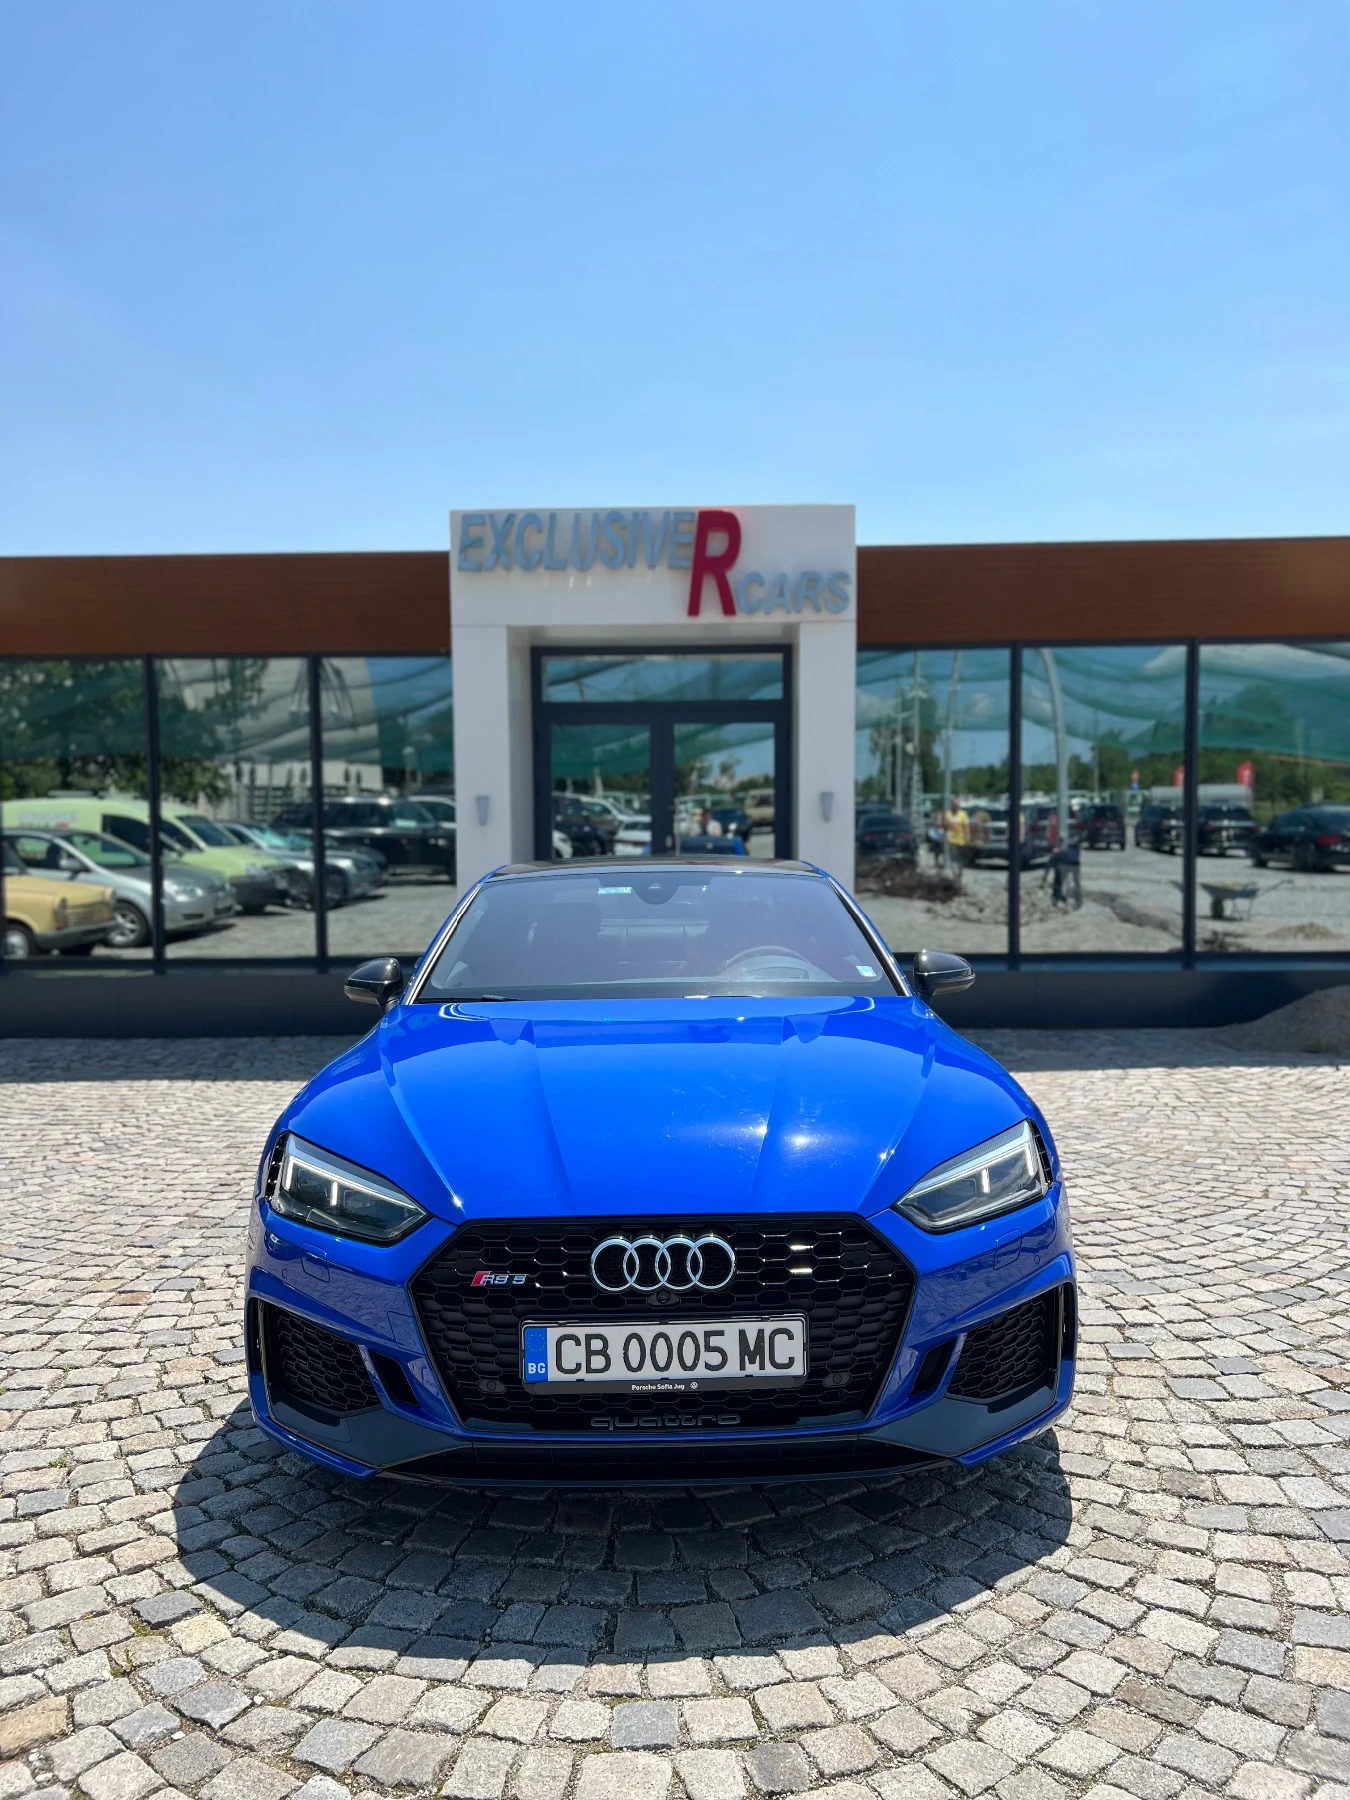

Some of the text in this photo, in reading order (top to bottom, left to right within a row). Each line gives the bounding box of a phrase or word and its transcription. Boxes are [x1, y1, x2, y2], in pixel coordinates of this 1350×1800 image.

[457, 508, 742, 617] EXCLUSIVE R
[737, 571, 852, 615] CARS
[479, 1274, 509, 1285] RS
[555, 1328, 796, 1374] CB 0005 MC
[528, 1363, 546, 1374] BG
[673, 1383, 685, 1391] Jug
[590, 1413, 741, 1431] quattro
